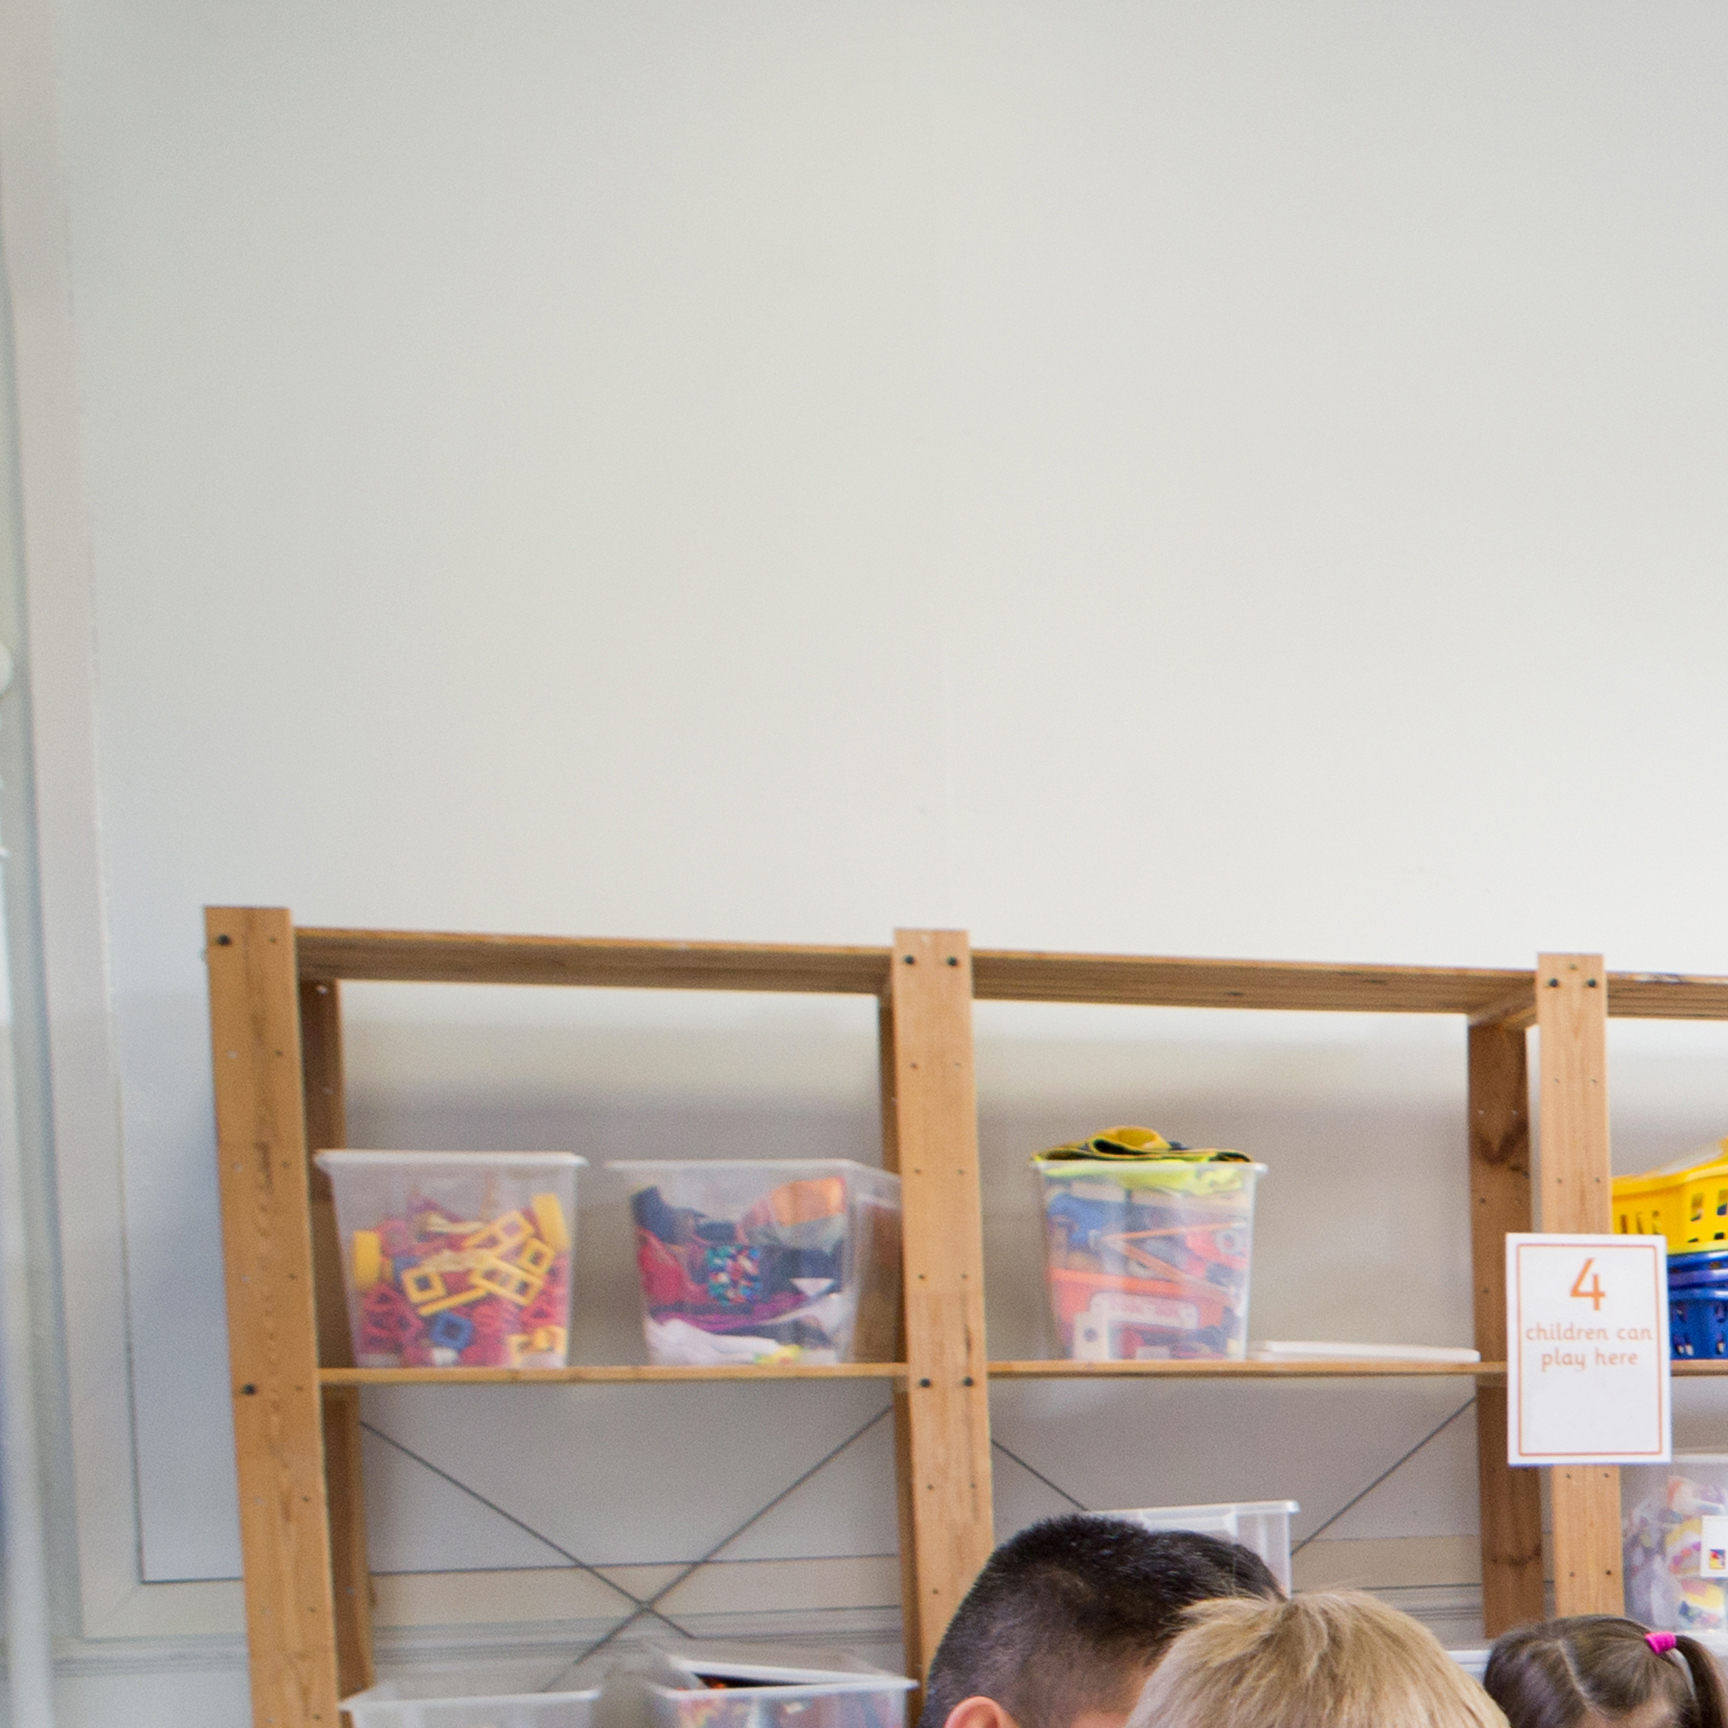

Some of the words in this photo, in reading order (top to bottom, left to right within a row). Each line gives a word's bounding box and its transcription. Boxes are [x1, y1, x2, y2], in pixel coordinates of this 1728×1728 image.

[1570, 1258, 1605, 1311] 4
[1525, 1322, 1609, 1341] children
[1616, 1327, 1652, 1341] can
[1541, 1347, 1586, 1373] play
[1595, 1347, 1638, 1365] here
